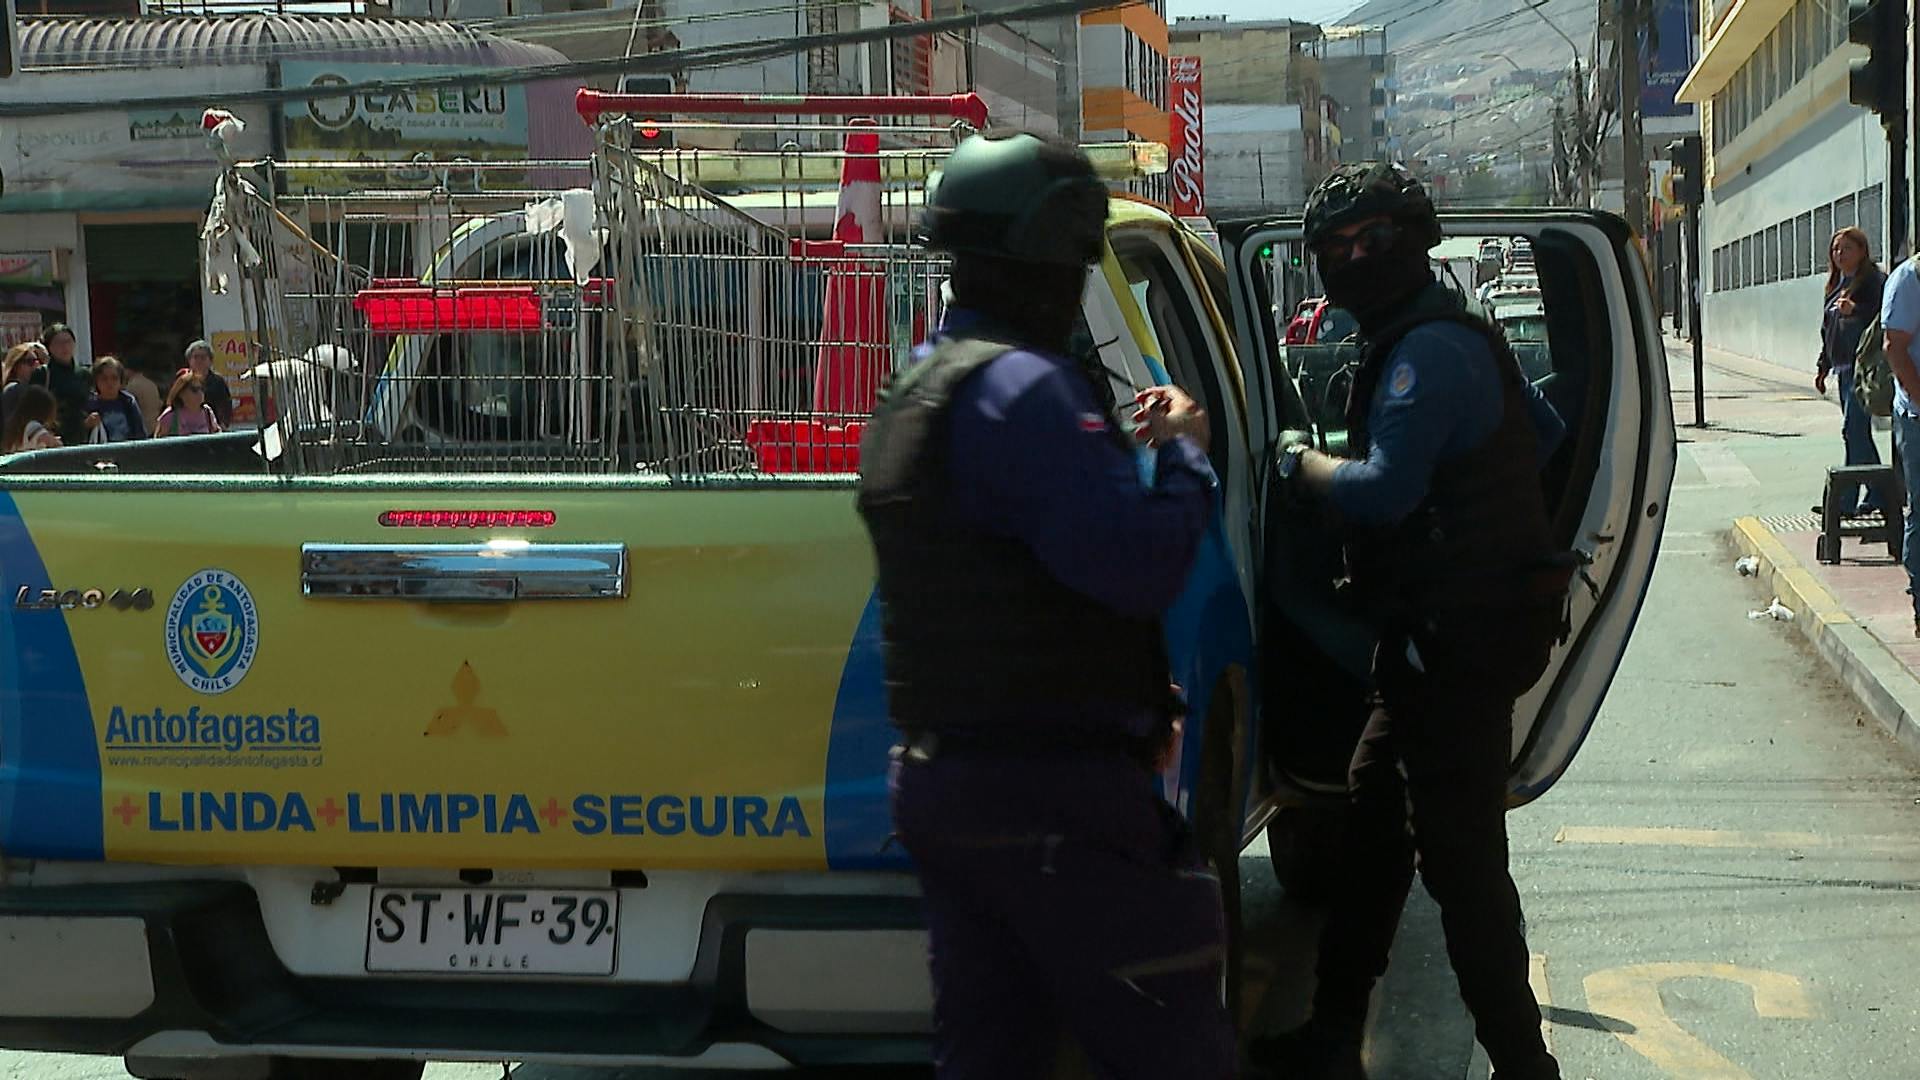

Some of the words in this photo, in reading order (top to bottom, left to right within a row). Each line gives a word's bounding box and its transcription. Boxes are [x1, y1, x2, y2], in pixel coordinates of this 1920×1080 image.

[1172, 87, 1203, 215] Paola
[168, 577, 203, 674] MUNICIPALIDAD
[206, 573, 224, 584] DE
[227, 579, 257, 670] ANTOFAGASTA
[192, 676, 232, 691] CHILE
[105, 706, 320, 752] Antofagasta
[449, 954, 530, 970] CHILE
